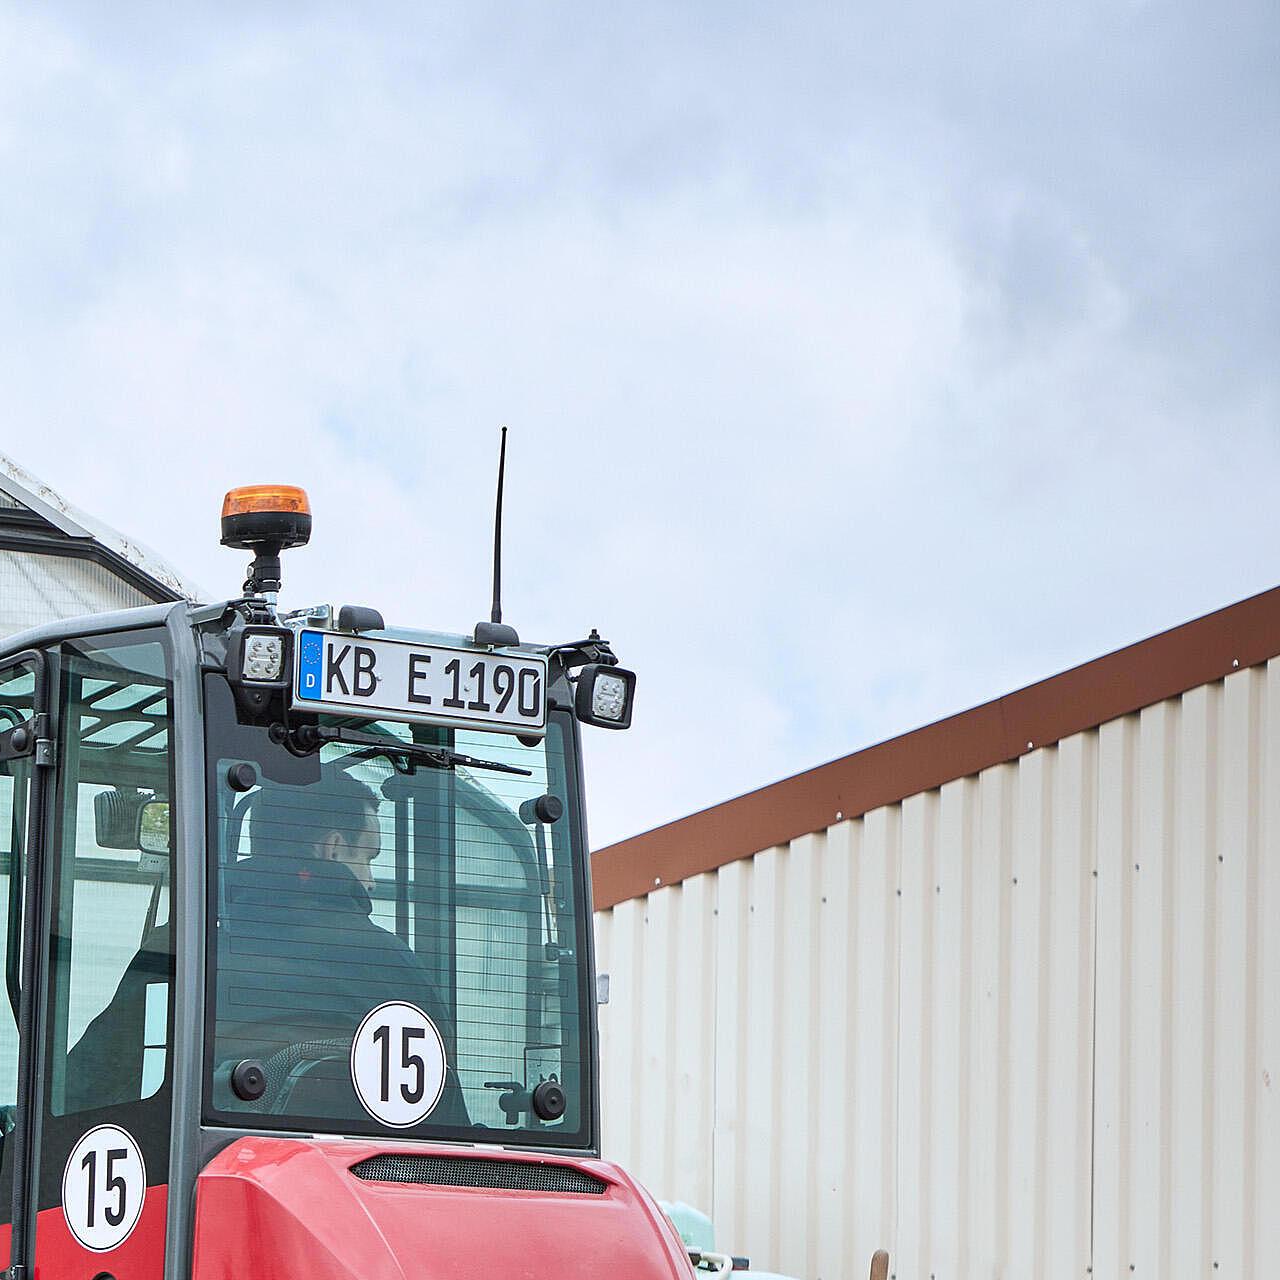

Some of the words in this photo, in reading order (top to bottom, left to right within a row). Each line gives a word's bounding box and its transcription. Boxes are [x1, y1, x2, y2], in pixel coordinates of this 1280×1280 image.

[306, 673, 316, 688] D
[326, 643, 378, 697] KB
[408, 653, 432, 705] E
[443, 659, 540, 717] 1190
[373, 1025, 425, 1105] 15
[81, 1148, 128, 1228] 15
